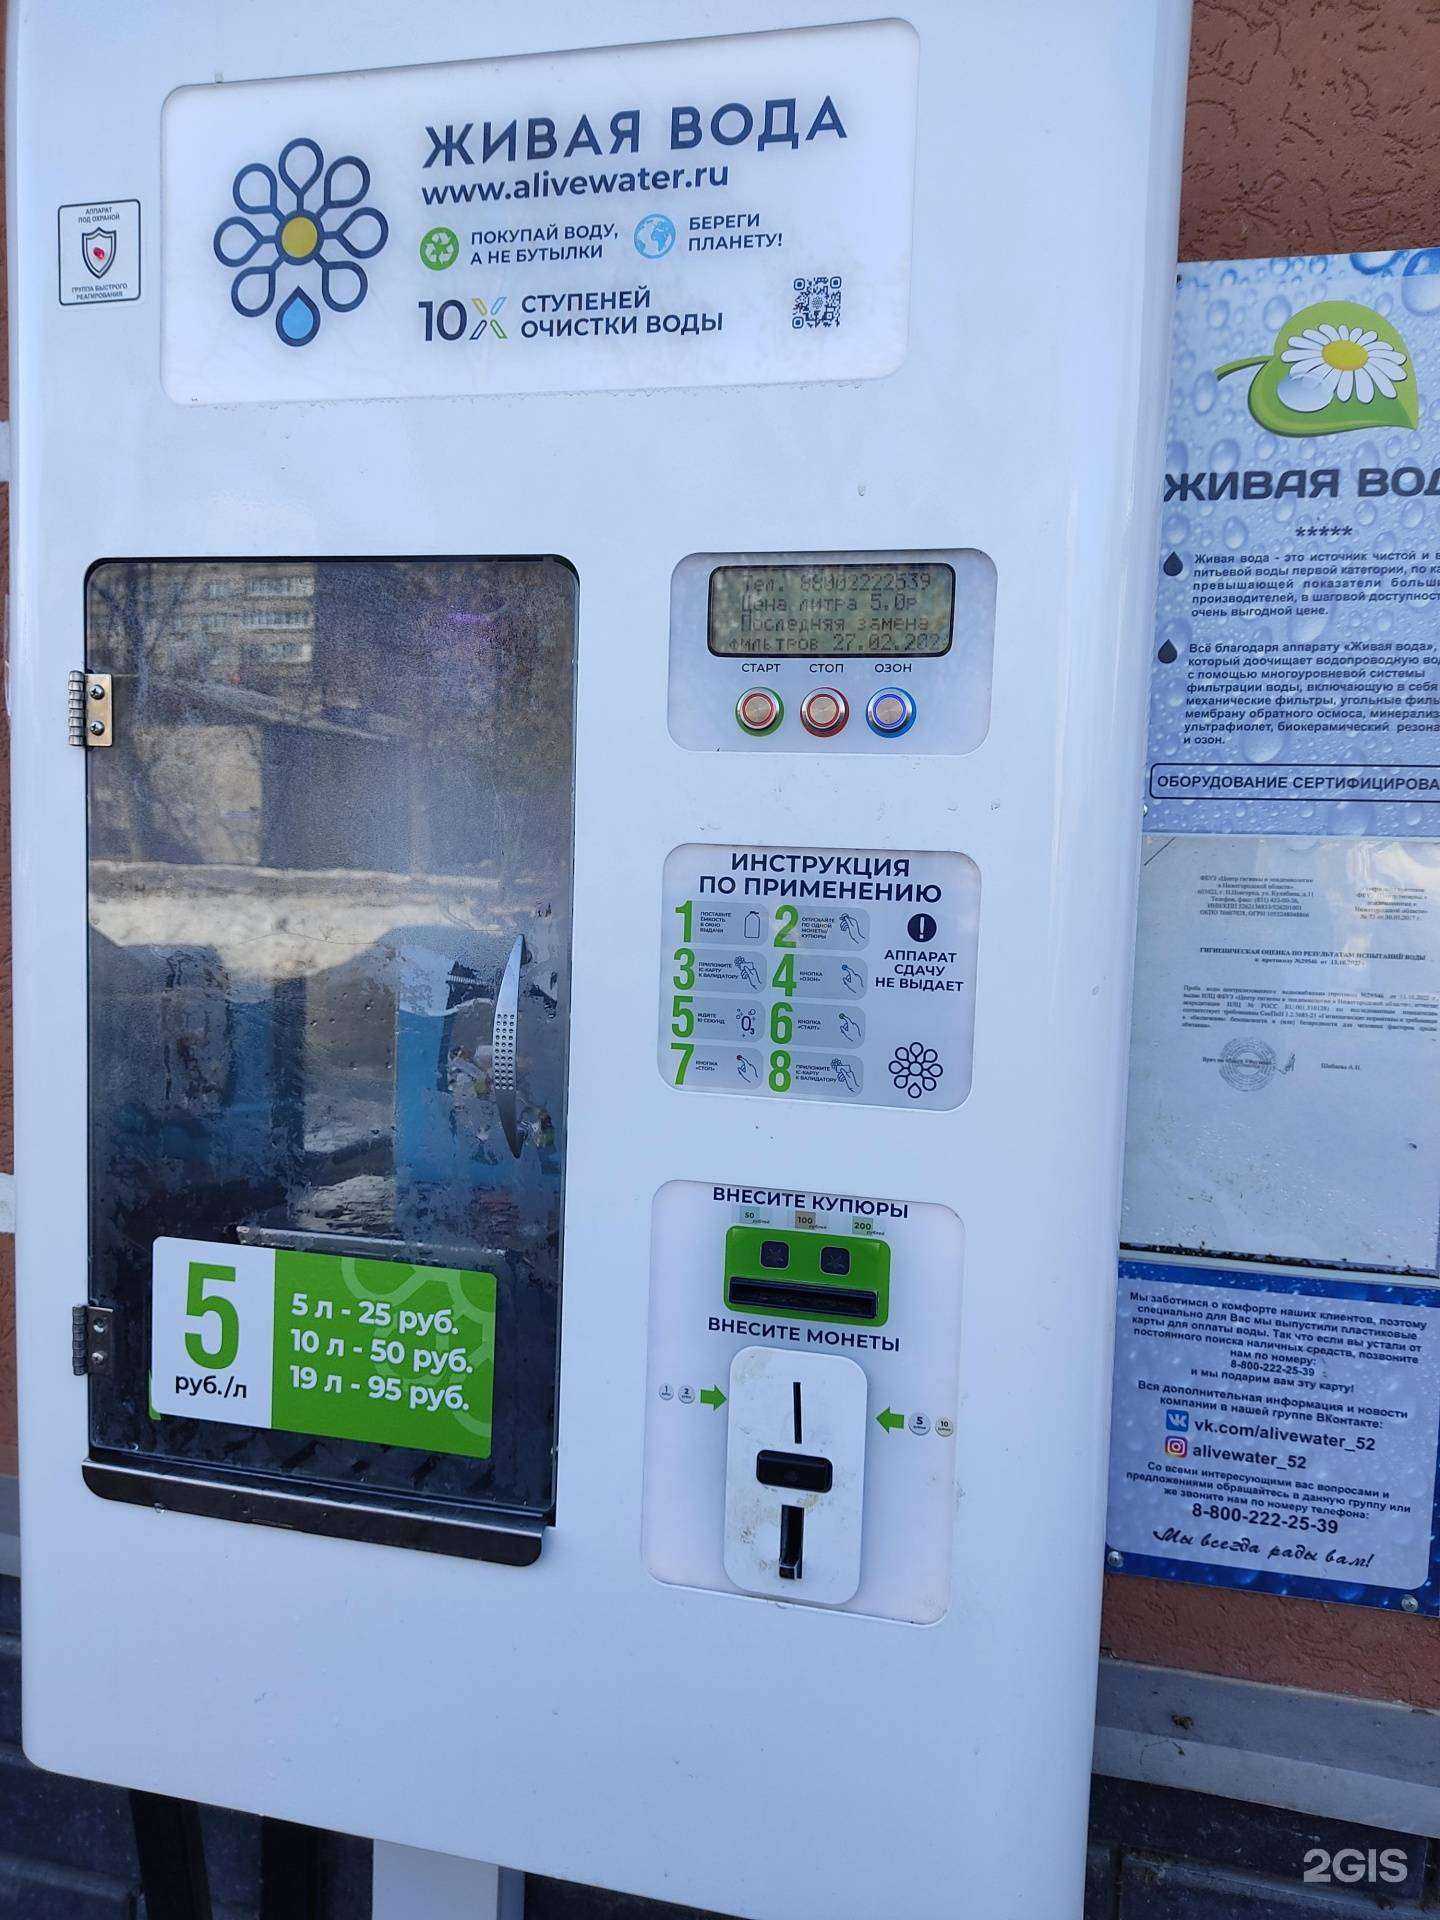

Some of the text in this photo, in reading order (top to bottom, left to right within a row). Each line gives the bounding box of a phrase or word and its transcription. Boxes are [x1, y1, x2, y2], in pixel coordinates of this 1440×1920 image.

[422, 95, 848, 168] ЖИВАЯ ВОДА
[422, 165, 728, 206] www.alivewater.ru
[471, 223, 618, 245] ПОКУПАЙ ВОДУ,
[689, 214, 759, 231] БЕРЕГИ
[470, 245, 603, 265] А НЕ БУТЫЛКИ
[688, 232, 782, 252] ПЛАНЕТУ!
[521, 286, 650, 314] СТУПЕНЕЙ
[521, 311, 723, 339] ОЧИСТКИ ВОДЫ
[1164, 469, 1339, 501] ЖИВАЯ
[1195, 551, 1416, 564] Живая вода источник чистой
[1194, 566, 1407, 577] питьевой воды первой категории,
[1193, 580, 1381, 591] превышающей показатели
[1193, 592, 1366, 605] производителей, шаговой
[1191, 606, 1328, 617] очень выгодной цене.
[1188, 656, 1419, 667] который доочищает водопроводную
[1215, 644, 1340, 654] благодаря аппарату
[742, 664, 912, 673] СТАРТ СТОП ОЗОН
[1198, 671, 1257, 679] помощью
[1261, 670, 1366, 680] многоуровневой
[1186, 696, 1401, 707] механические фильтры, угольные
[1187, 682, 1438, 694] фильтрации включающую себя
[1184, 721, 1389, 733] ультрафиолет, биокерамический
[1185, 709, 1366, 720] мембрану обратного осмоса,
[1195, 736, 1225, 744] озон.
[1158, 775, 1288, 789] ОБОРУДОВАНИЕ
[732, 852, 910, 878] ИНСТРУКЦИЯ
[700, 876, 942, 902] ПО ПРИМЕНЕНИЮ
[675, 900, 692, 943] 1
[774, 904, 799, 948] 2
[673, 948, 695, 990] 3
[884, 950, 956, 963] АППАРАТ
[772, 954, 796, 996] 4
[894, 964, 945, 977] СДАЧУ
[876, 977, 964, 992] НЕ ВЫДАЕТ
[672, 996, 694, 1038] 5
[770, 1002, 792, 1044] 6
[670, 1042, 694, 1085] 7
[768, 1050, 791, 1092] 8
[713, 1186, 908, 1219] ВНЕСИТЕ КУПЮРЫ
[797, 1216, 813, 1225] 100
[854, 1222, 872, 1231] 200
[185, 1262, 239, 1370] 5
[291, 1293, 458, 1337] 5 л 25 руб.
[1138, 1306, 1417, 1339] специально выпустили пластиковые
[1151, 1296, 1427, 1331] заботимся комфорте наших клиентов, поэтому
[709, 1317, 899, 1352] ВНЕСИТЕ МОНЕТЫ
[1132, 1317, 1164, 1326] карты
[1192, 1324, 1233, 1333] оплаты
[1237, 1328, 1269, 1337] воды.
[1367, 1341, 1405, 1352] устали
[1134, 1329, 1418, 1363] постоянного поиска наличных средств, позвоните
[291, 1328, 473, 1374] 10 л 50 руб.
[1271, 1355, 1316, 1366] номеру:
[1230, 1360, 1314, 1376] 8-800-222-25-39
[175, 1374, 246, 1399] руб./л
[290, 1365, 470, 1411] 19 л 95 руб.
[1222, 1373, 1354, 1393] подарим карту!
[1160, 1397, 1382, 1428] компании нашей группе ВКонтакте:
[1163, 1386, 1408, 1418] дополнительная информация новости
[1195, 1419, 1375, 1452] vk.com/alivewater_52
[1193, 1445, 1306, 1470] alivewater_52
[1126, 1472, 1386, 1511] предложениями обращайтесь данную группу
[1165, 1466, 1379, 1498] всеми интересующими вопросами
[1181, 1491, 1369, 1519] звоните номеру телефона:
[1192, 1503, 1338, 1533] 8-800-222-25-39
[1153, 1527, 1374, 1567] Мы всегда рады вам!
